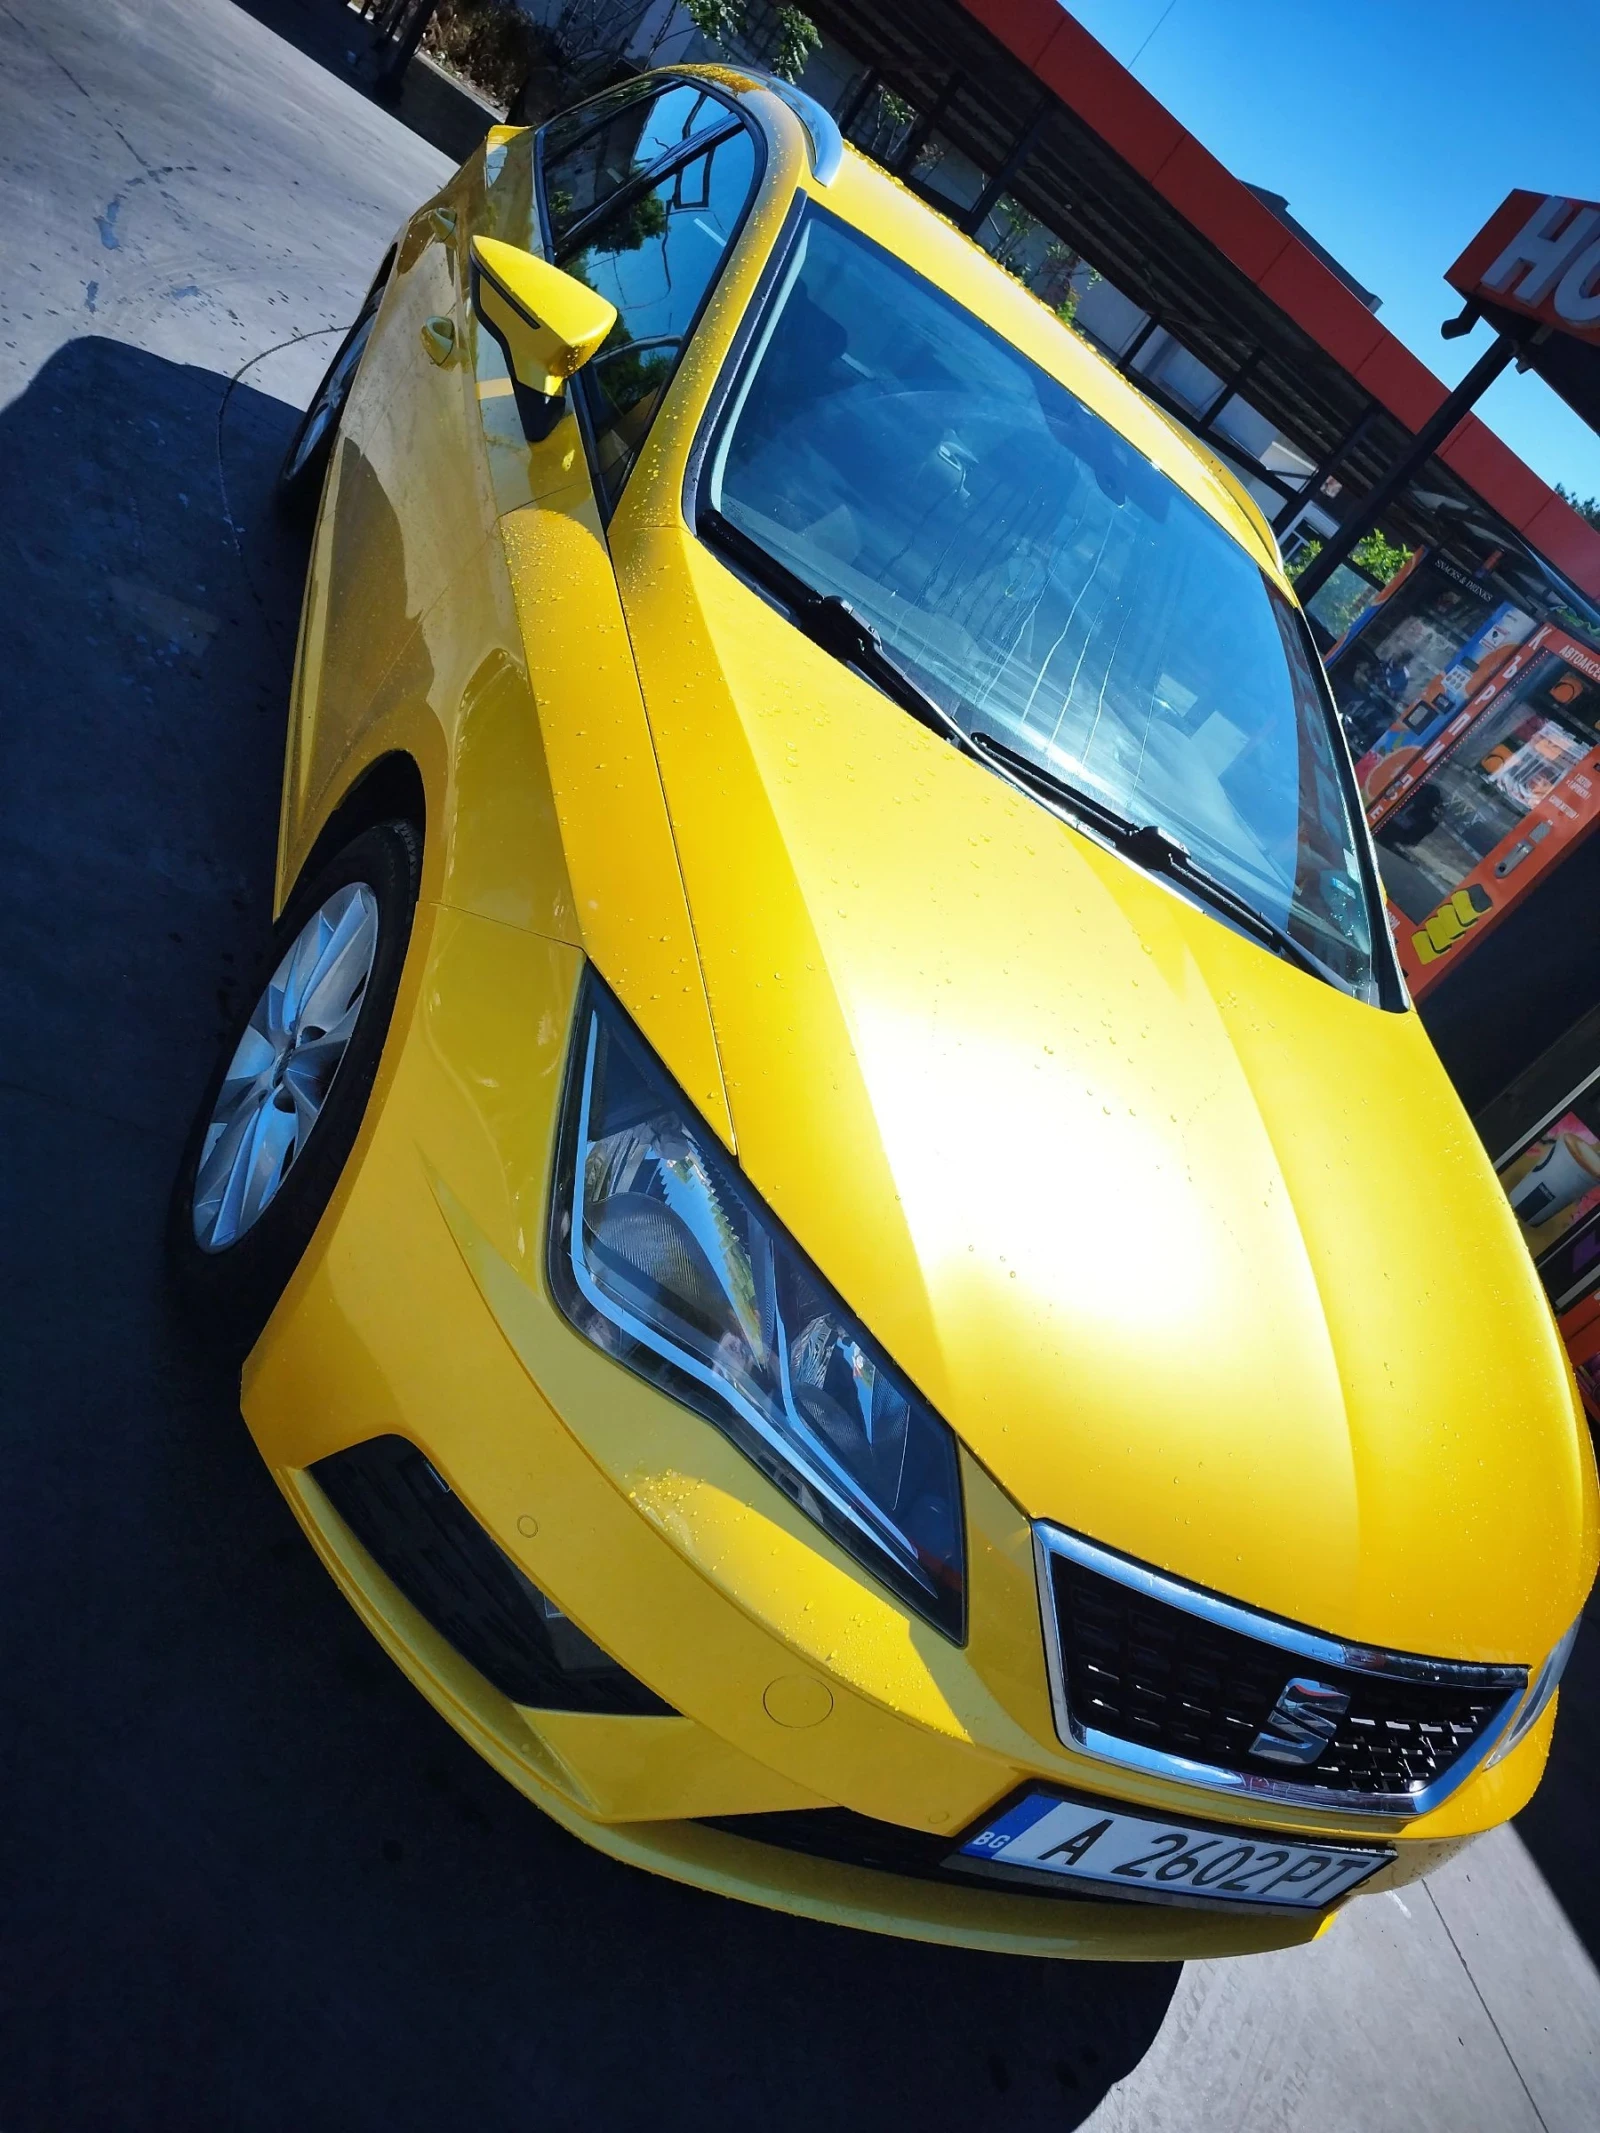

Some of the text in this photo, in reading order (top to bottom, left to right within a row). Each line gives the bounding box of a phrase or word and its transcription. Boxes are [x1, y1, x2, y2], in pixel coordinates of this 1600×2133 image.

[1434, 559, 1461, 580] SNACKS
[1465, 580, 1493, 602] DRINKS
[1559, 644, 1600, 681] АВТОАКСЕ
[1422, 625, 1553, 764] КЪРПИ
[973, 1831, 1011, 1849] BG
